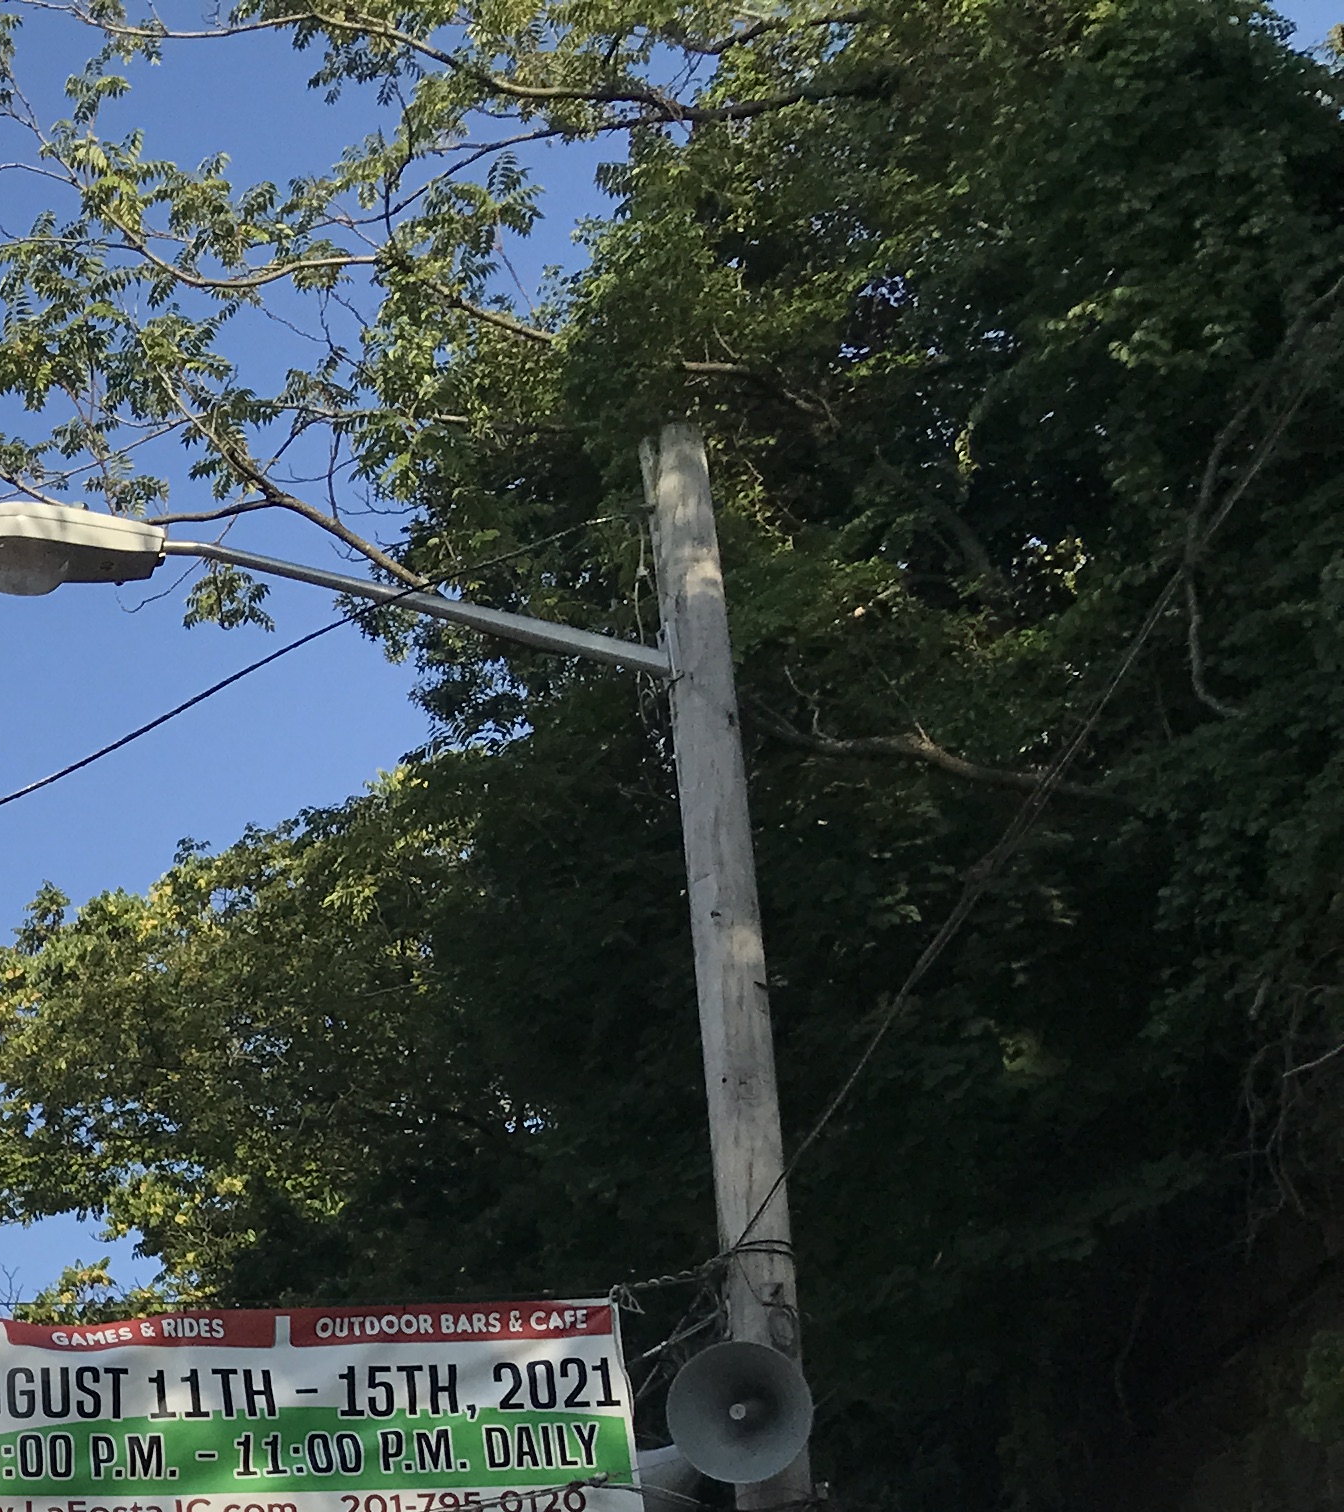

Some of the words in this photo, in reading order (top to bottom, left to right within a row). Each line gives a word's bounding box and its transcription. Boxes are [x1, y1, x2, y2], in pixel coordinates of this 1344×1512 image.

[50, 1323, 134, 1347] GAMES
[140, 1319, 156, 1339] &
[162, 1318, 226, 1340] RIDES
[314, 1314, 435, 1339] OUTDOOR
[442, 1313, 490, 1335] BARS
[492, 1312, 509, 1333] &
[512, 1309, 589, 1333] CAFE
[146, 1367, 279, 1420] 11TH
[293, 1385, 320, 1396] -
[337, 1361, 479, 1422] 15TH,
[491, 1356, 622, 1410] 2021
[90, 1435, 179, 1482] P.M.
[194, 1449, 220, 1461] -
[233, 1431, 364, 1479] 11:00
[379, 1425, 469, 1475] P.M.
[484, 1422, 599, 1470] DAILY
